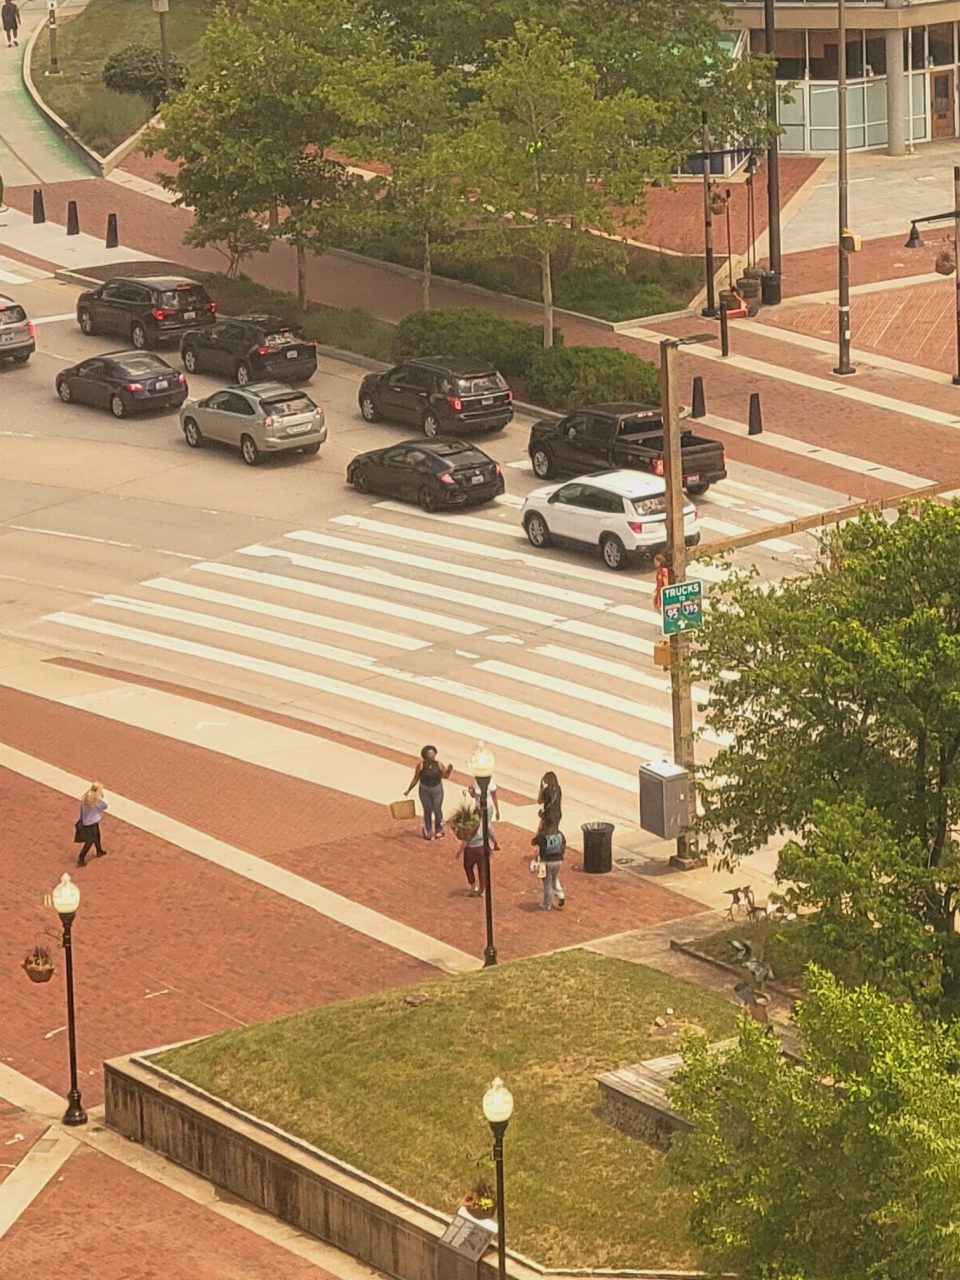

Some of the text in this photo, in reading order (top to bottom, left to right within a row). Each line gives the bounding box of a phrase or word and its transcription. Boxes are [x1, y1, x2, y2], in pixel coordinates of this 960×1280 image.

[665, 583, 699, 598] TRUCKS
[667, 604, 698, 619] 95 395
